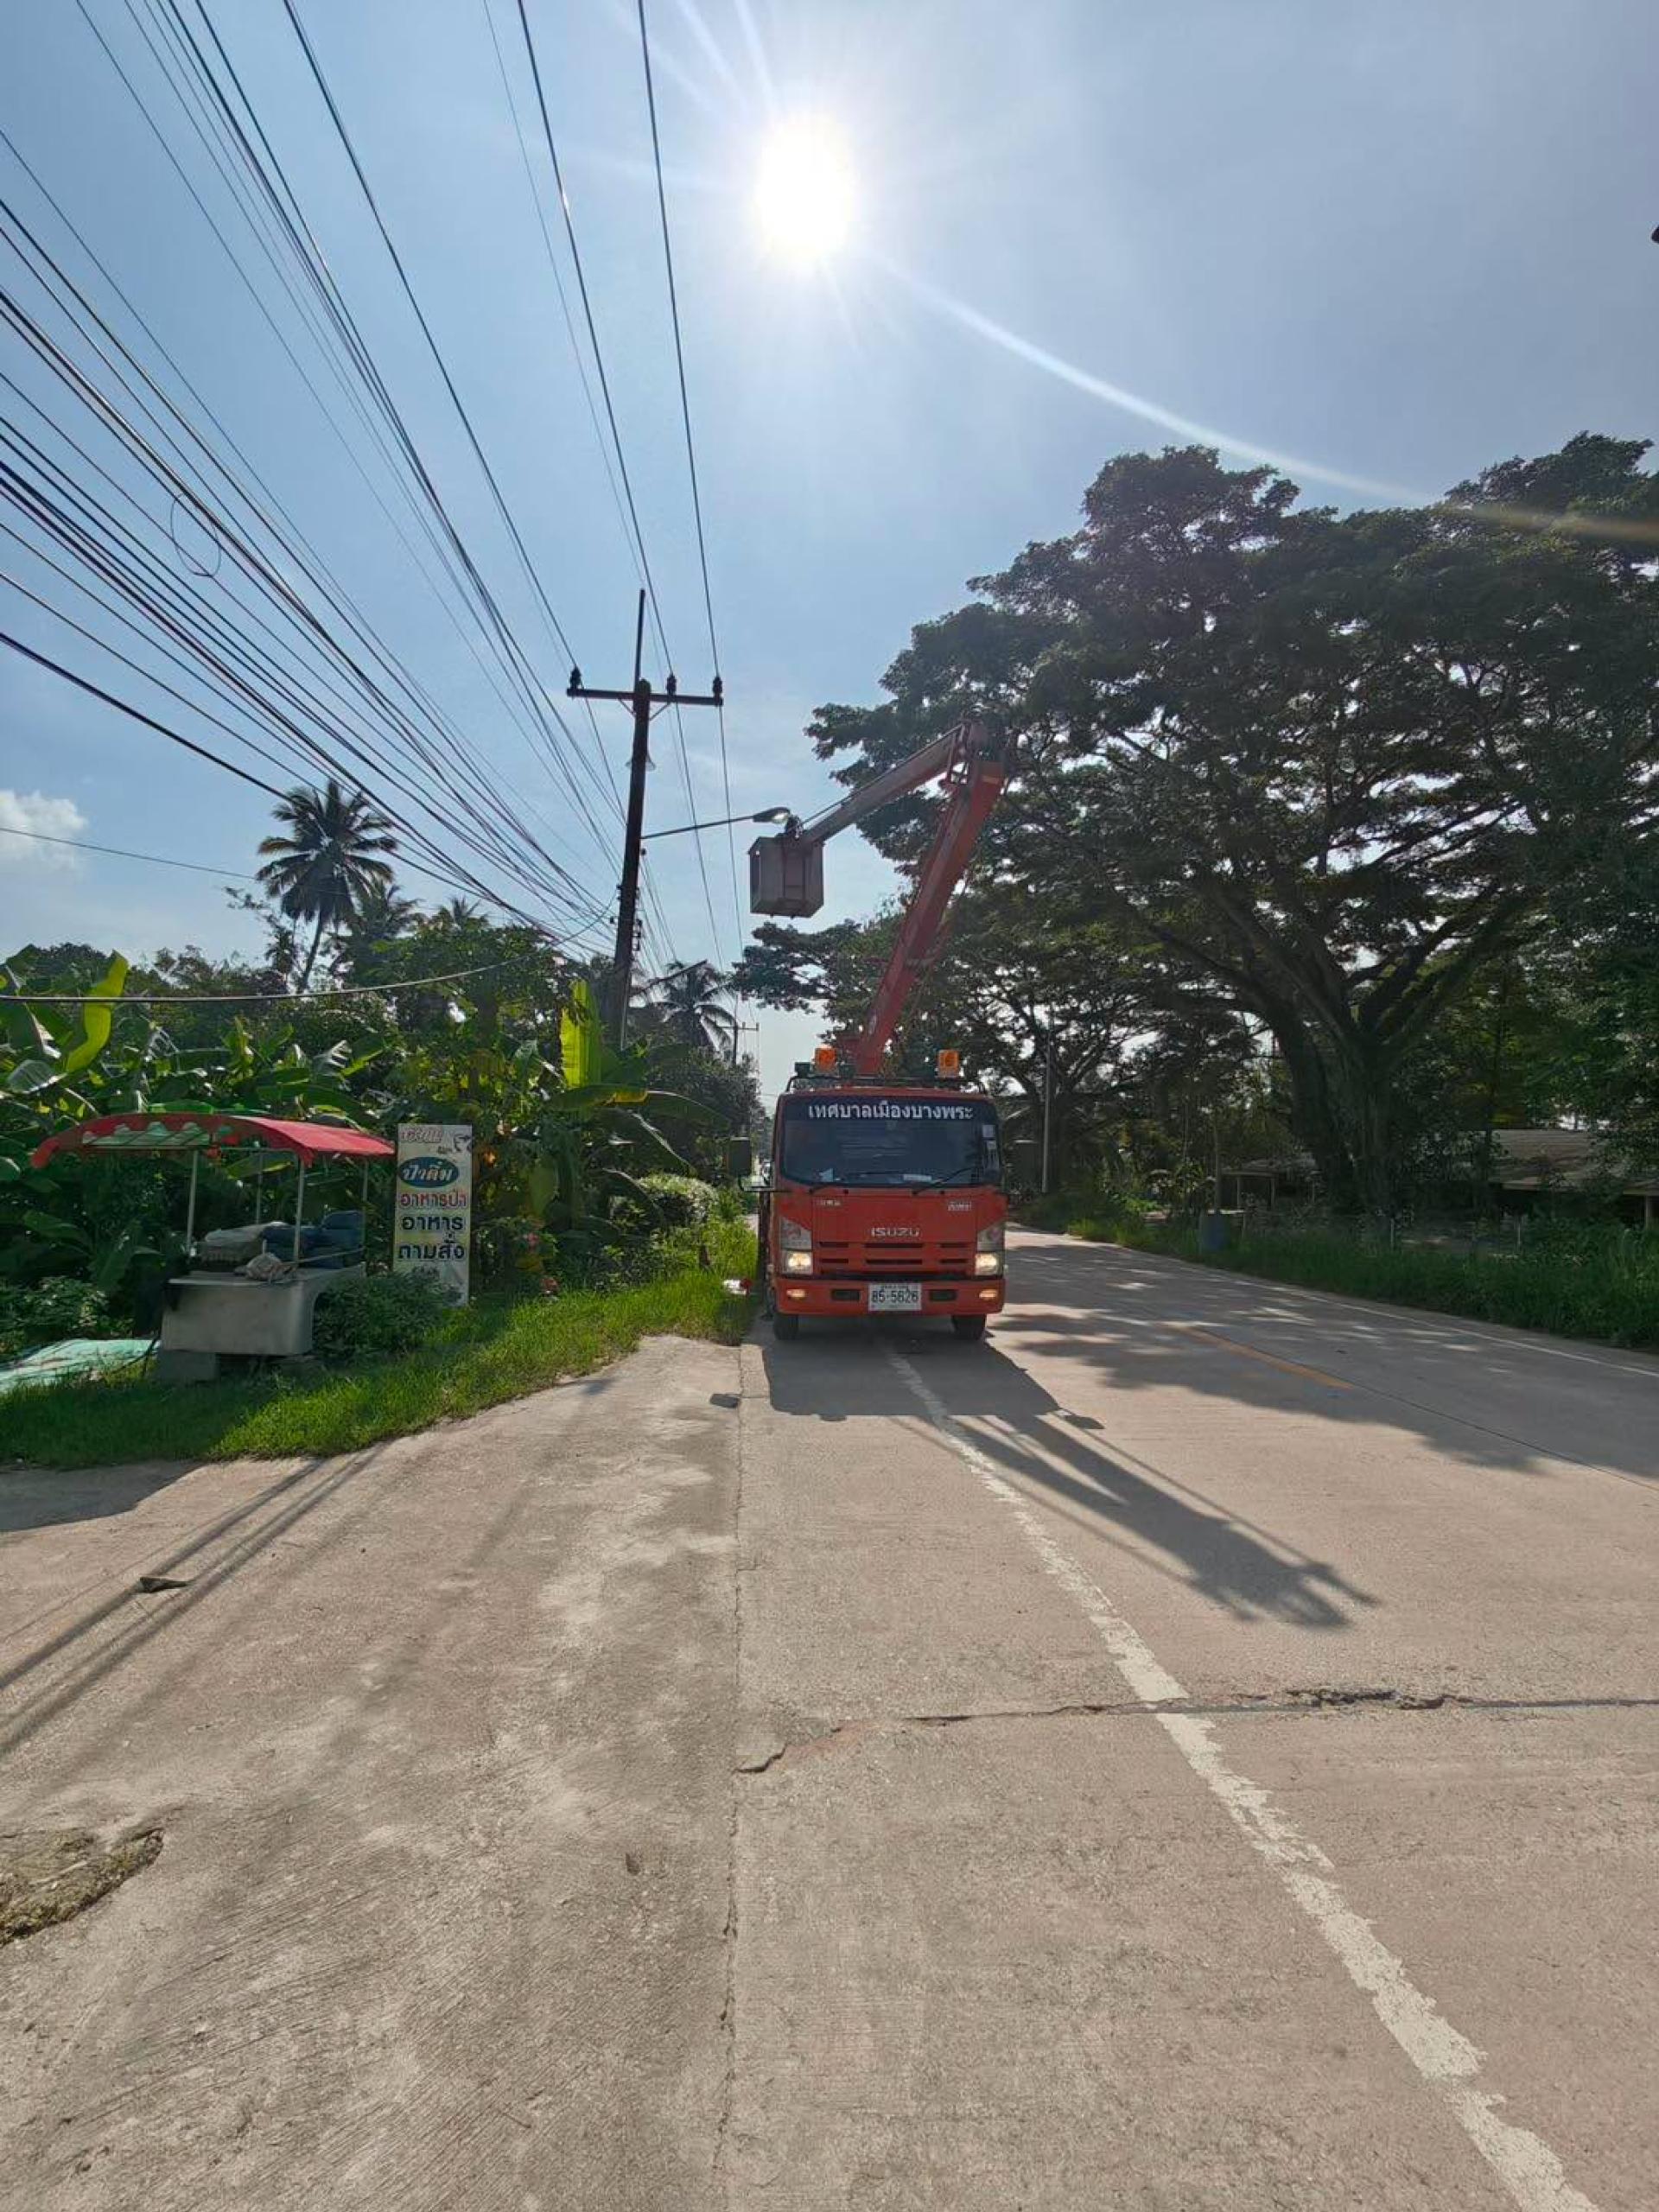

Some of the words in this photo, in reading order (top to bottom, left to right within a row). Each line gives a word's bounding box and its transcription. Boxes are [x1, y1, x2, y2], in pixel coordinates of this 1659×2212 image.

[809, 1099, 974, 1120] เทศบาลเมืองบางพระ
[402, 1216, 464, 1230] อาหาร
[871, 1227, 920, 1237] ISUZU
[398, 1232, 465, 1260] ตามสั่ง
